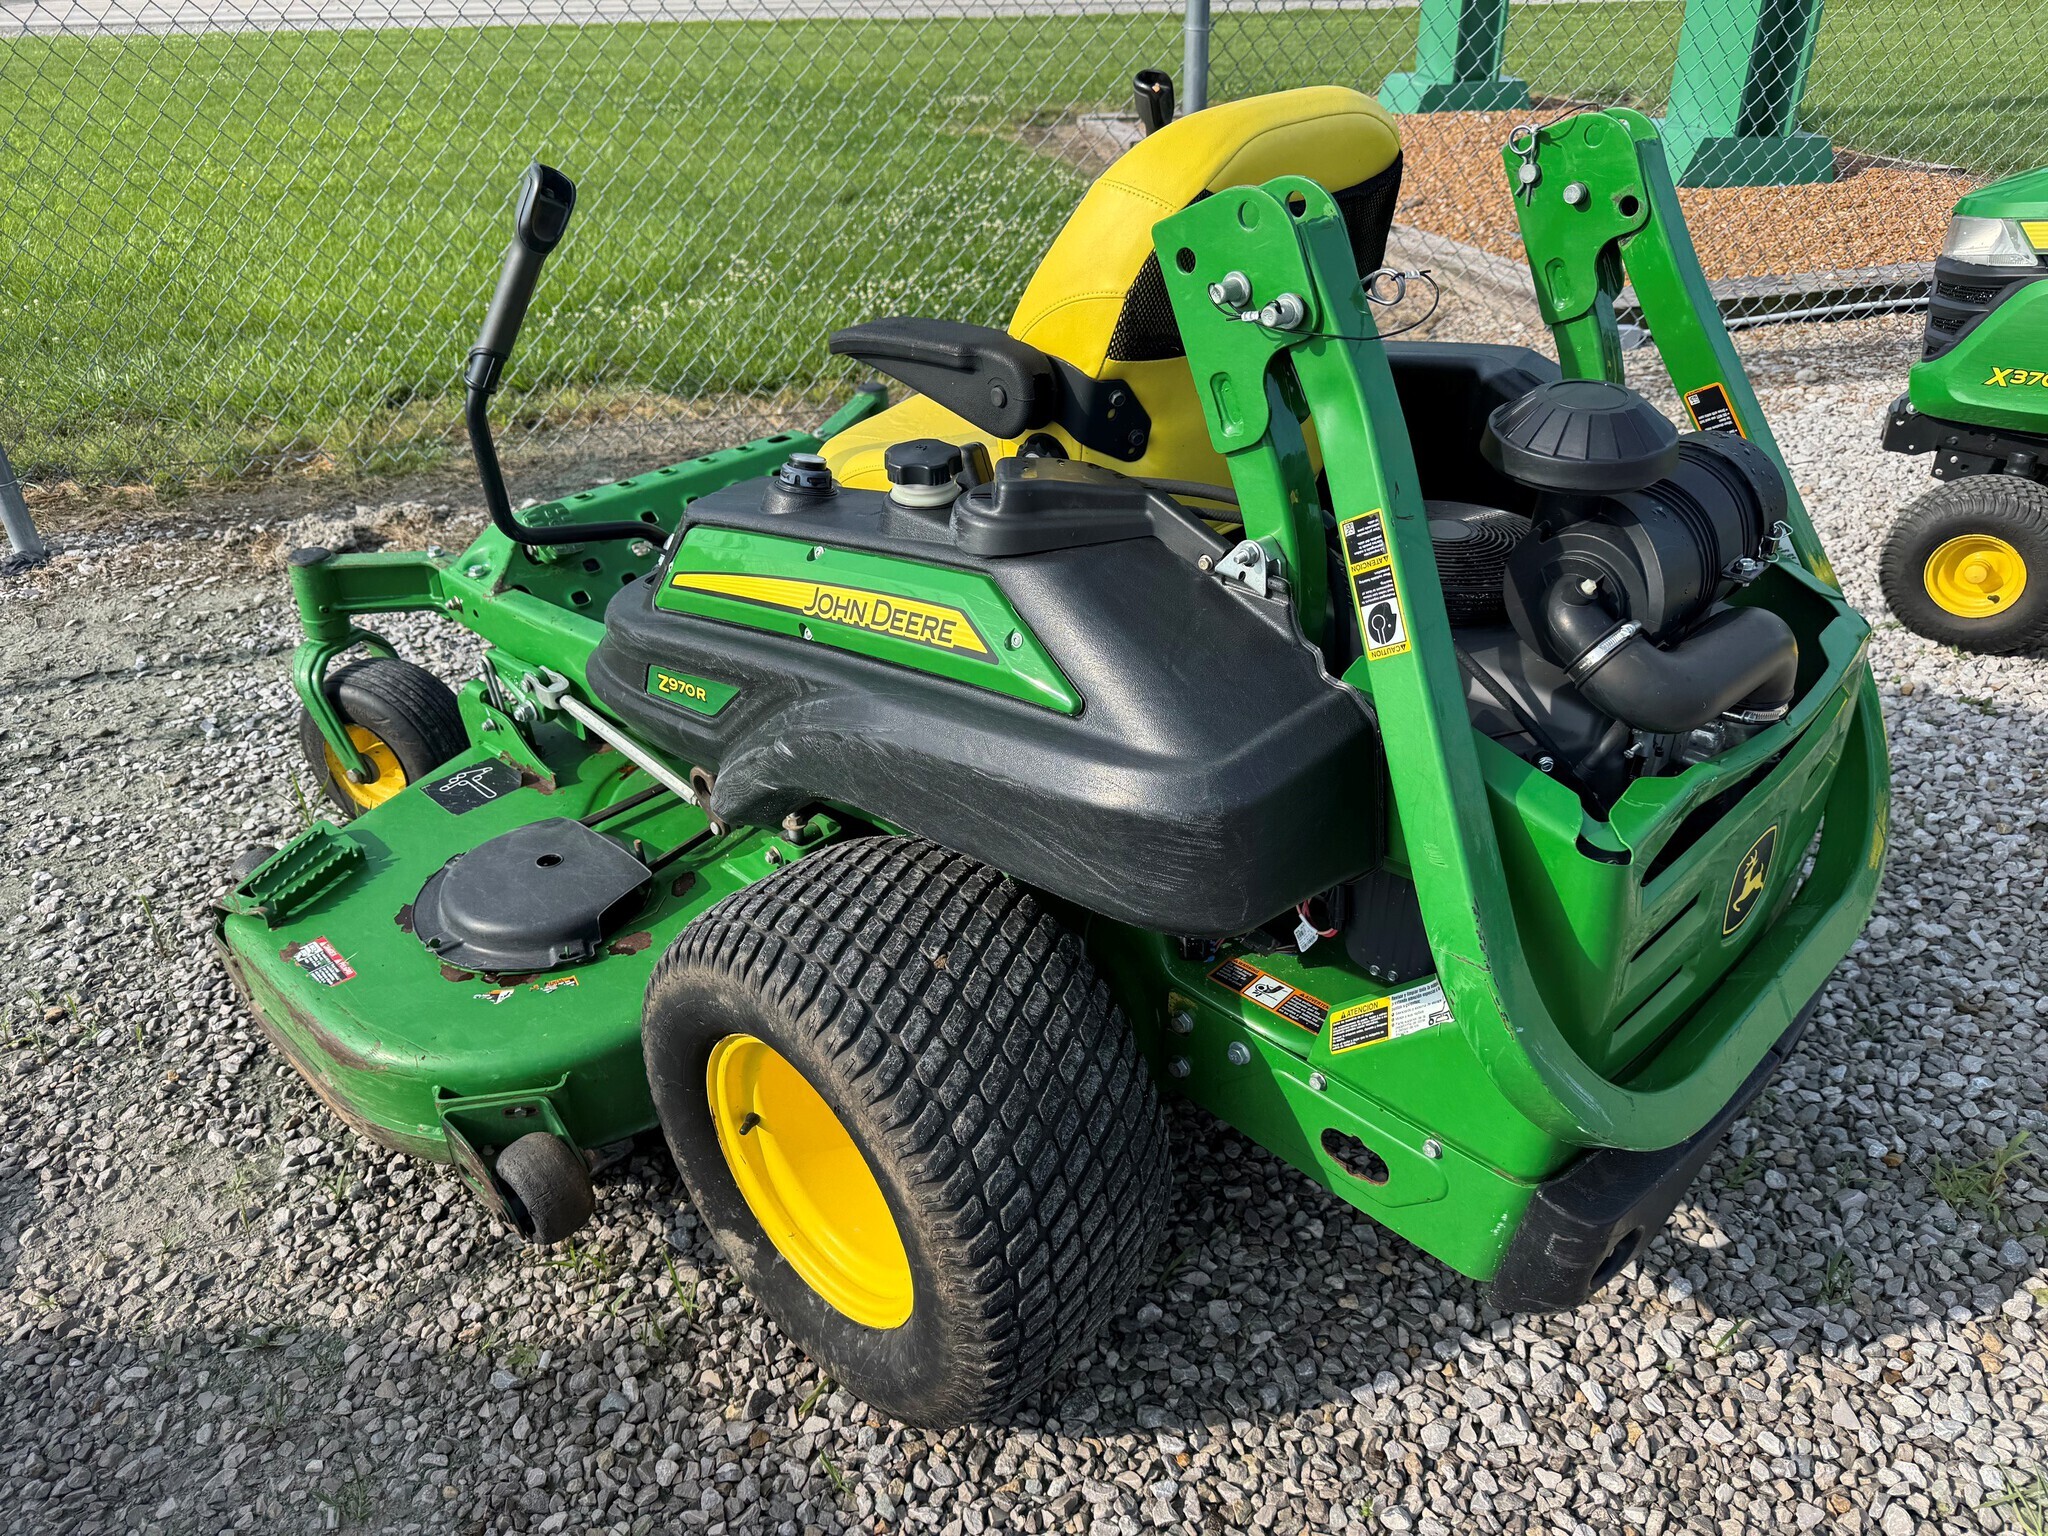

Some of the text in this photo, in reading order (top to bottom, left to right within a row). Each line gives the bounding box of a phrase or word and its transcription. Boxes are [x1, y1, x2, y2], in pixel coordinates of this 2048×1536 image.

[804, 586, 957, 644] JOHN DEERE
[1371, 645, 1401, 658] CAUTION
[657, 673, 707, 702] Z970R
